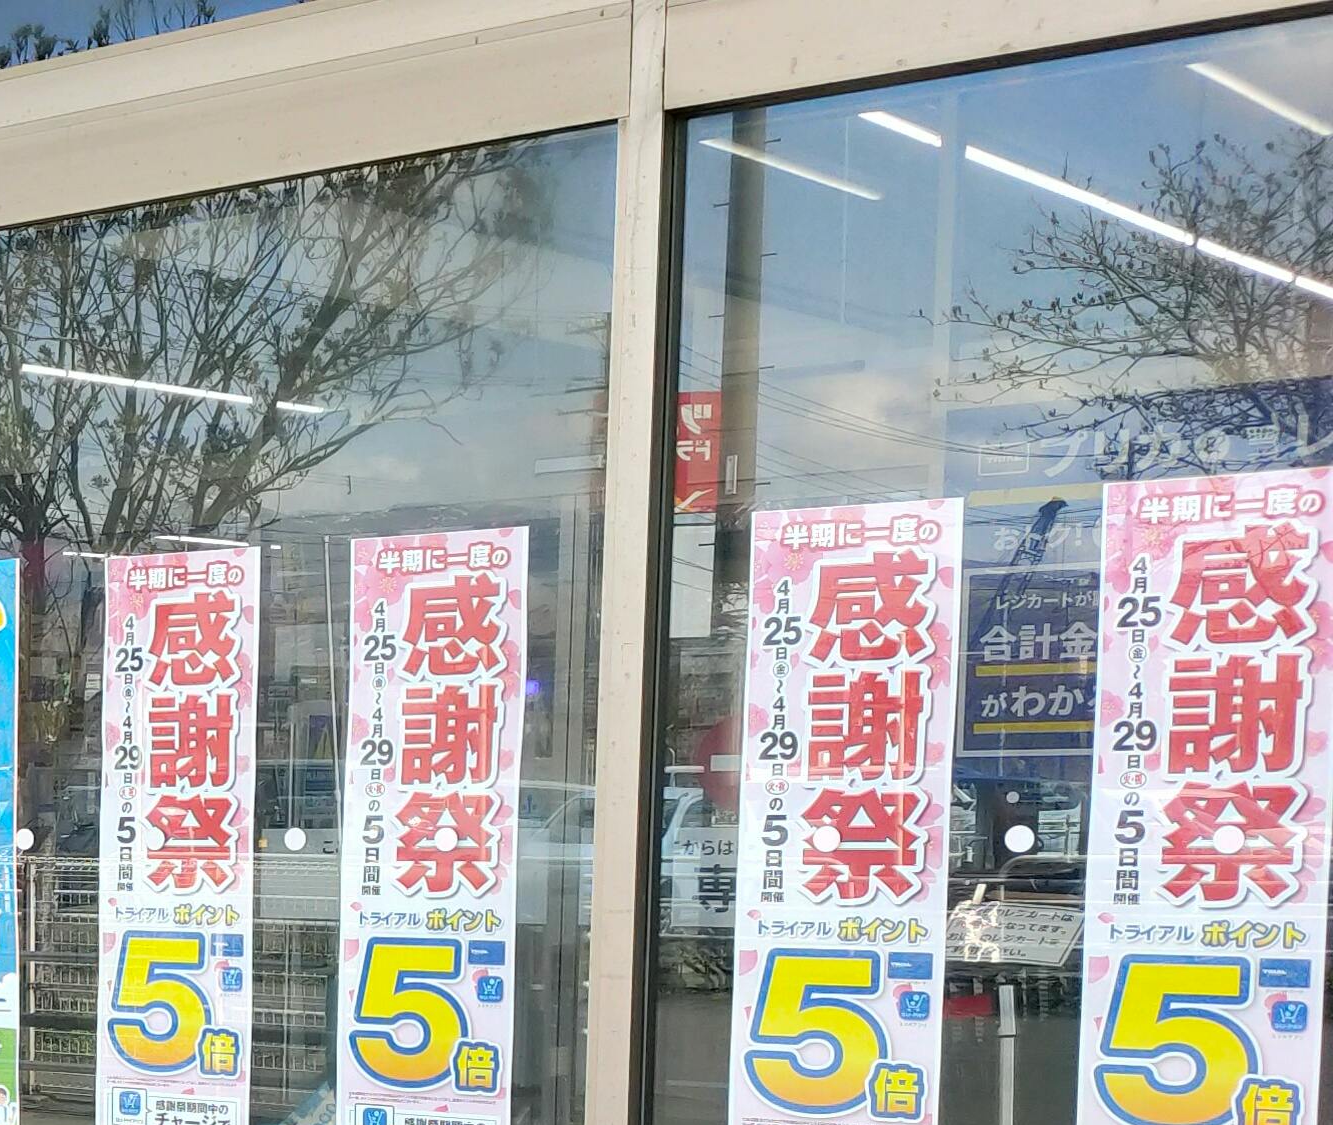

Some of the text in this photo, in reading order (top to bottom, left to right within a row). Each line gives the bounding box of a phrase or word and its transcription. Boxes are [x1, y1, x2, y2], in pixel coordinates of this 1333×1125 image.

[1140, 488, 1322, 525] 半期に一度の
[782, 517, 939, 550] 半期に一度の
[379, 543, 509, 573] 半期に一度の
[129, 564, 242, 590] 半期に一度の
[979, 621, 1098, 661] 合計金
[800, 549, 929, 900] 感謝祭
[1161, 522, 1310, 902] 感謝祭
[146, 591, 235, 888] 感謝祭
[395, 573, 501, 892] 感謝祭
[115, 904, 239, 925] トライアル ポイント
[358, 909, 501, 932] トライアル ポイント
[756, 917, 927, 943] トライアル ポイント
[1109, 920, 1306, 949] トライアル ポイント
[108, 930, 240, 1075] 5倍
[349, 937, 501, 1093] 5倍
[744, 947, 927, 1120] 5倍
[155, 1100, 229, 1116] 感謝祭期間中の
